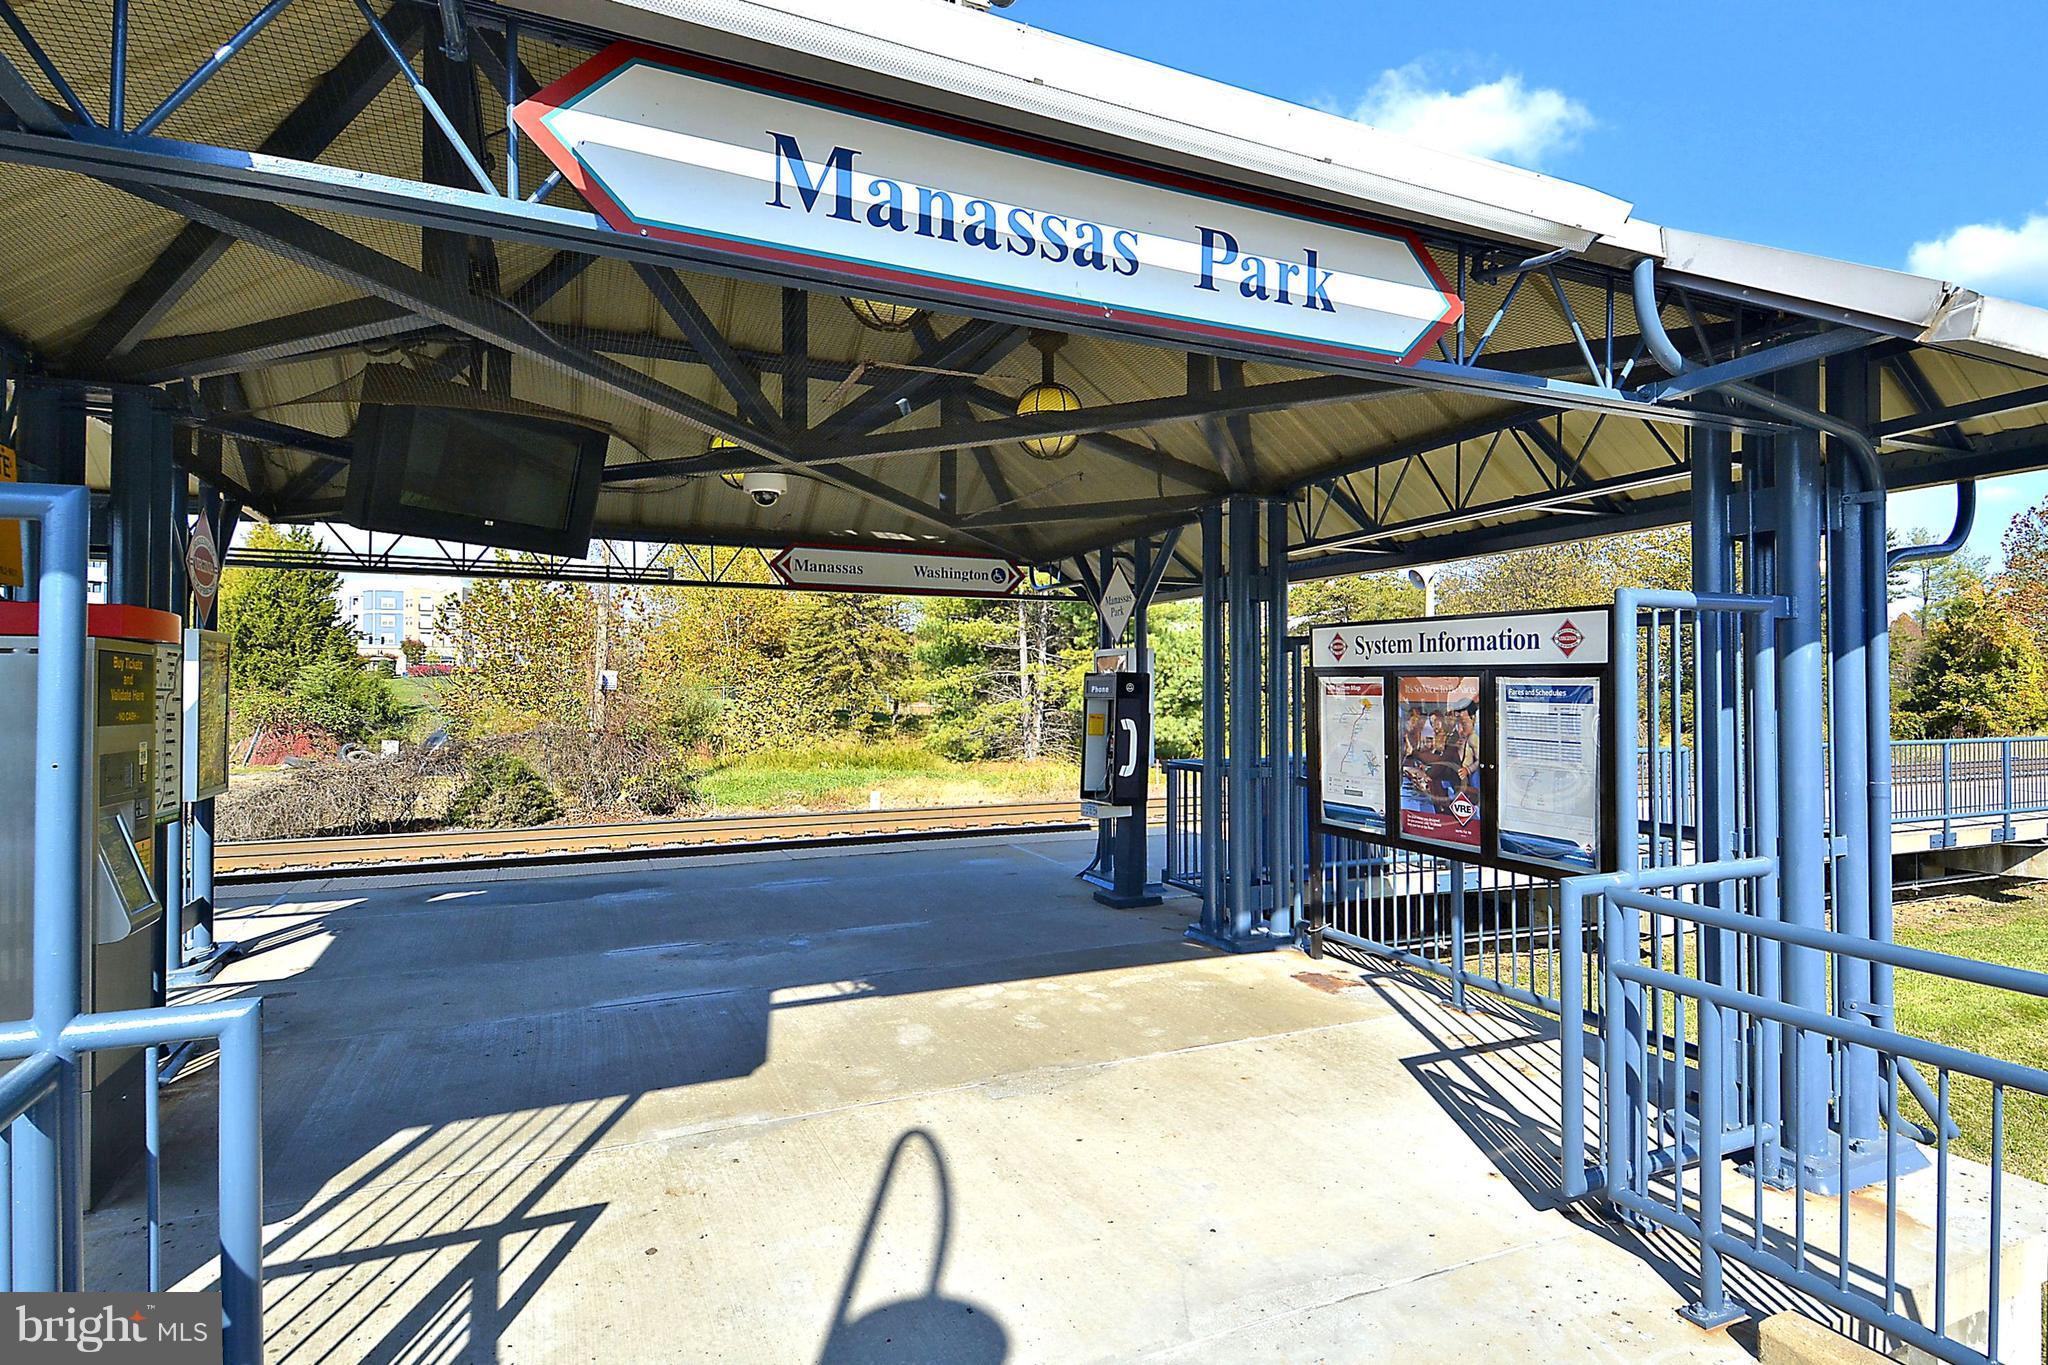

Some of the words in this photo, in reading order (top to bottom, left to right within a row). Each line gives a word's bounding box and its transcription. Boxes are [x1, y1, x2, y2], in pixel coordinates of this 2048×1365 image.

[765, 129, 1140, 277] Manassas
[1193, 225, 1337, 313] Park
[794, 558, 864, 575] Manassas
[914, 565, 989, 583] Washington
[1105, 594, 1132, 606] Manassas
[1110, 605, 1125, 617] Park
[1355, 635, 1413, 660] System
[1418, 627, 1541, 653] Information
[1091, 684, 1110, 693] Phone
[1508, 688, 1524, 696] Fares
[1525, 688, 1534, 696] and
[1535, 688, 1567, 697] Schedules
[1454, 804, 1472, 813] VRE
